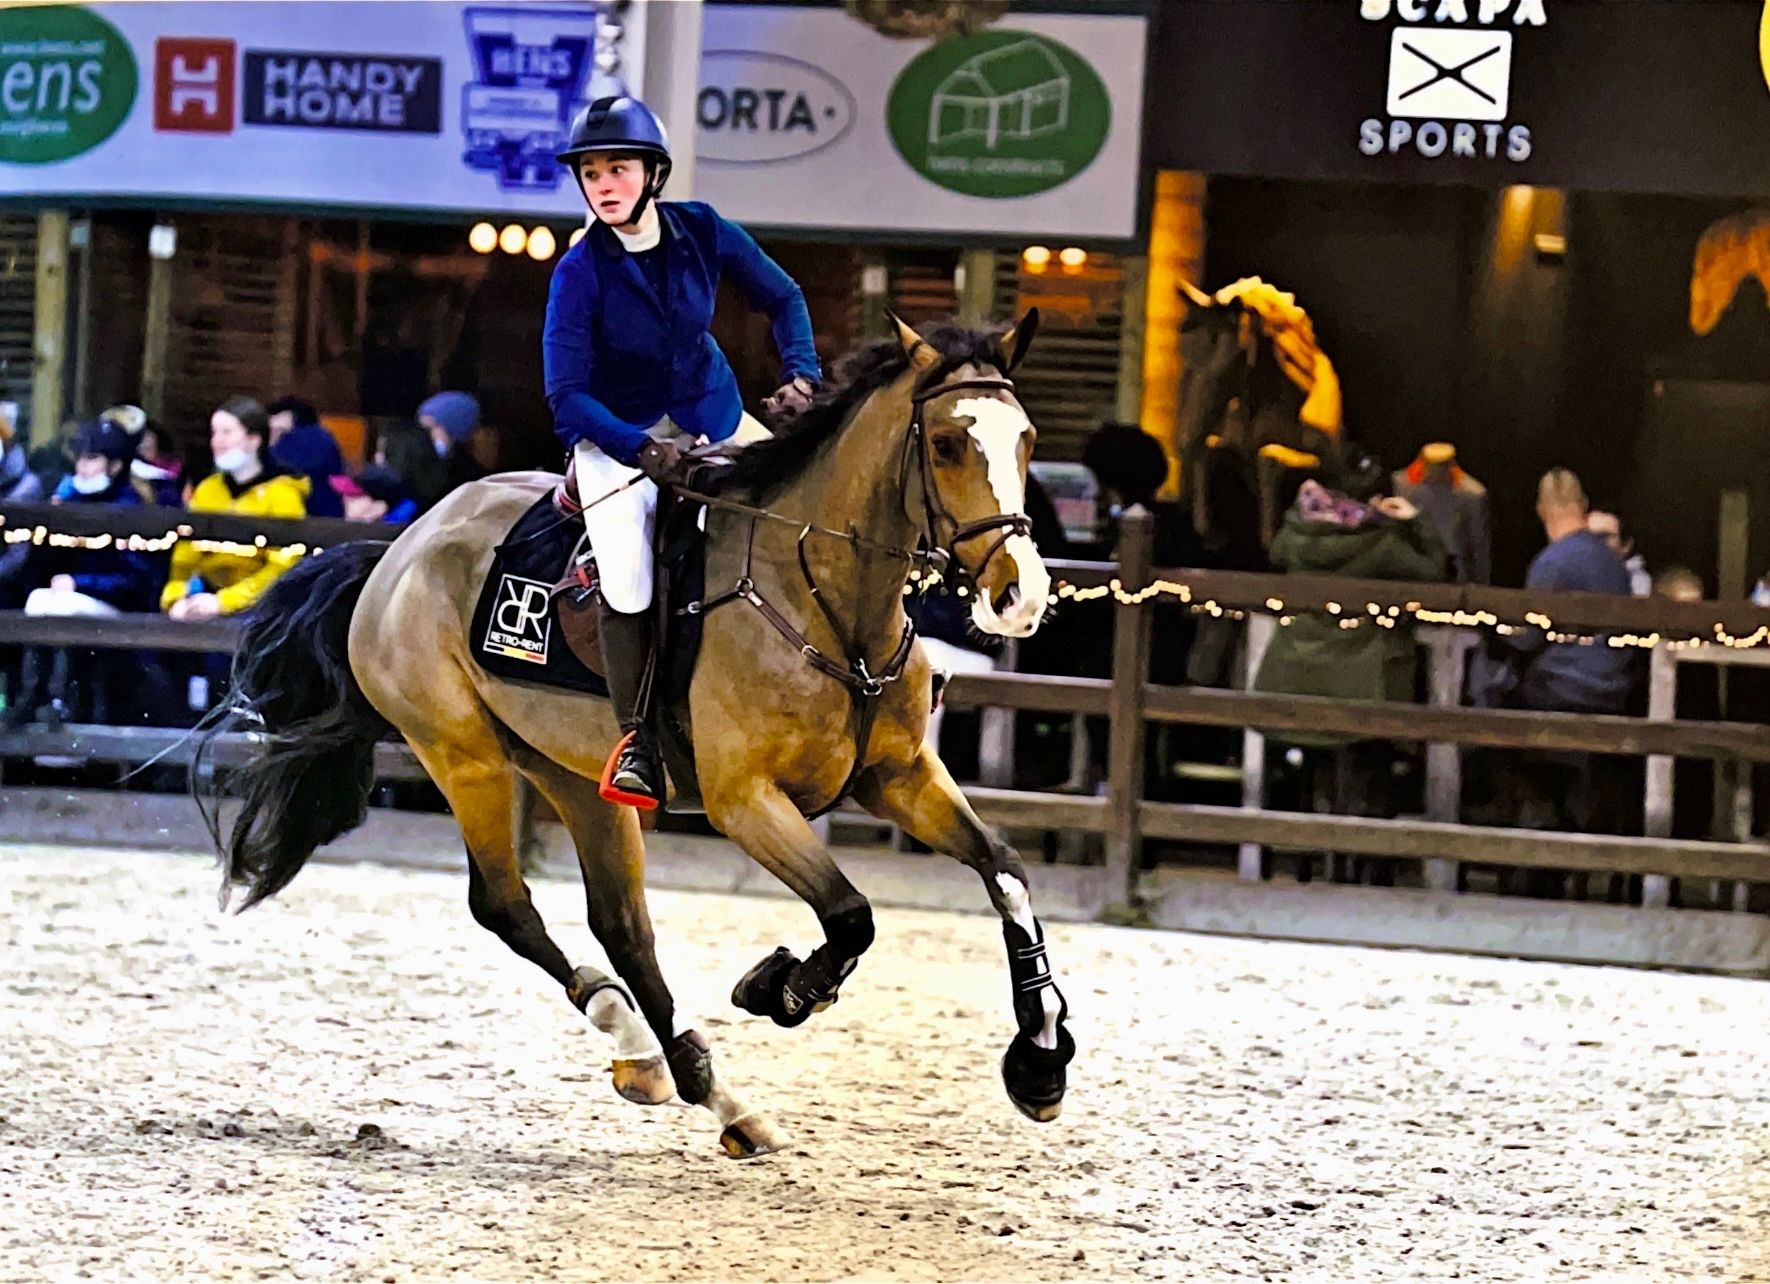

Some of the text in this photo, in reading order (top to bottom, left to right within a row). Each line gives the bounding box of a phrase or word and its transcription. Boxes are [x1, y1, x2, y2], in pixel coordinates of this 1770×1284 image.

[264, 57, 424, 94] HANDY
[264, 90, 405, 126] HOME
[1358, 118, 1532, 161] SPORTS
